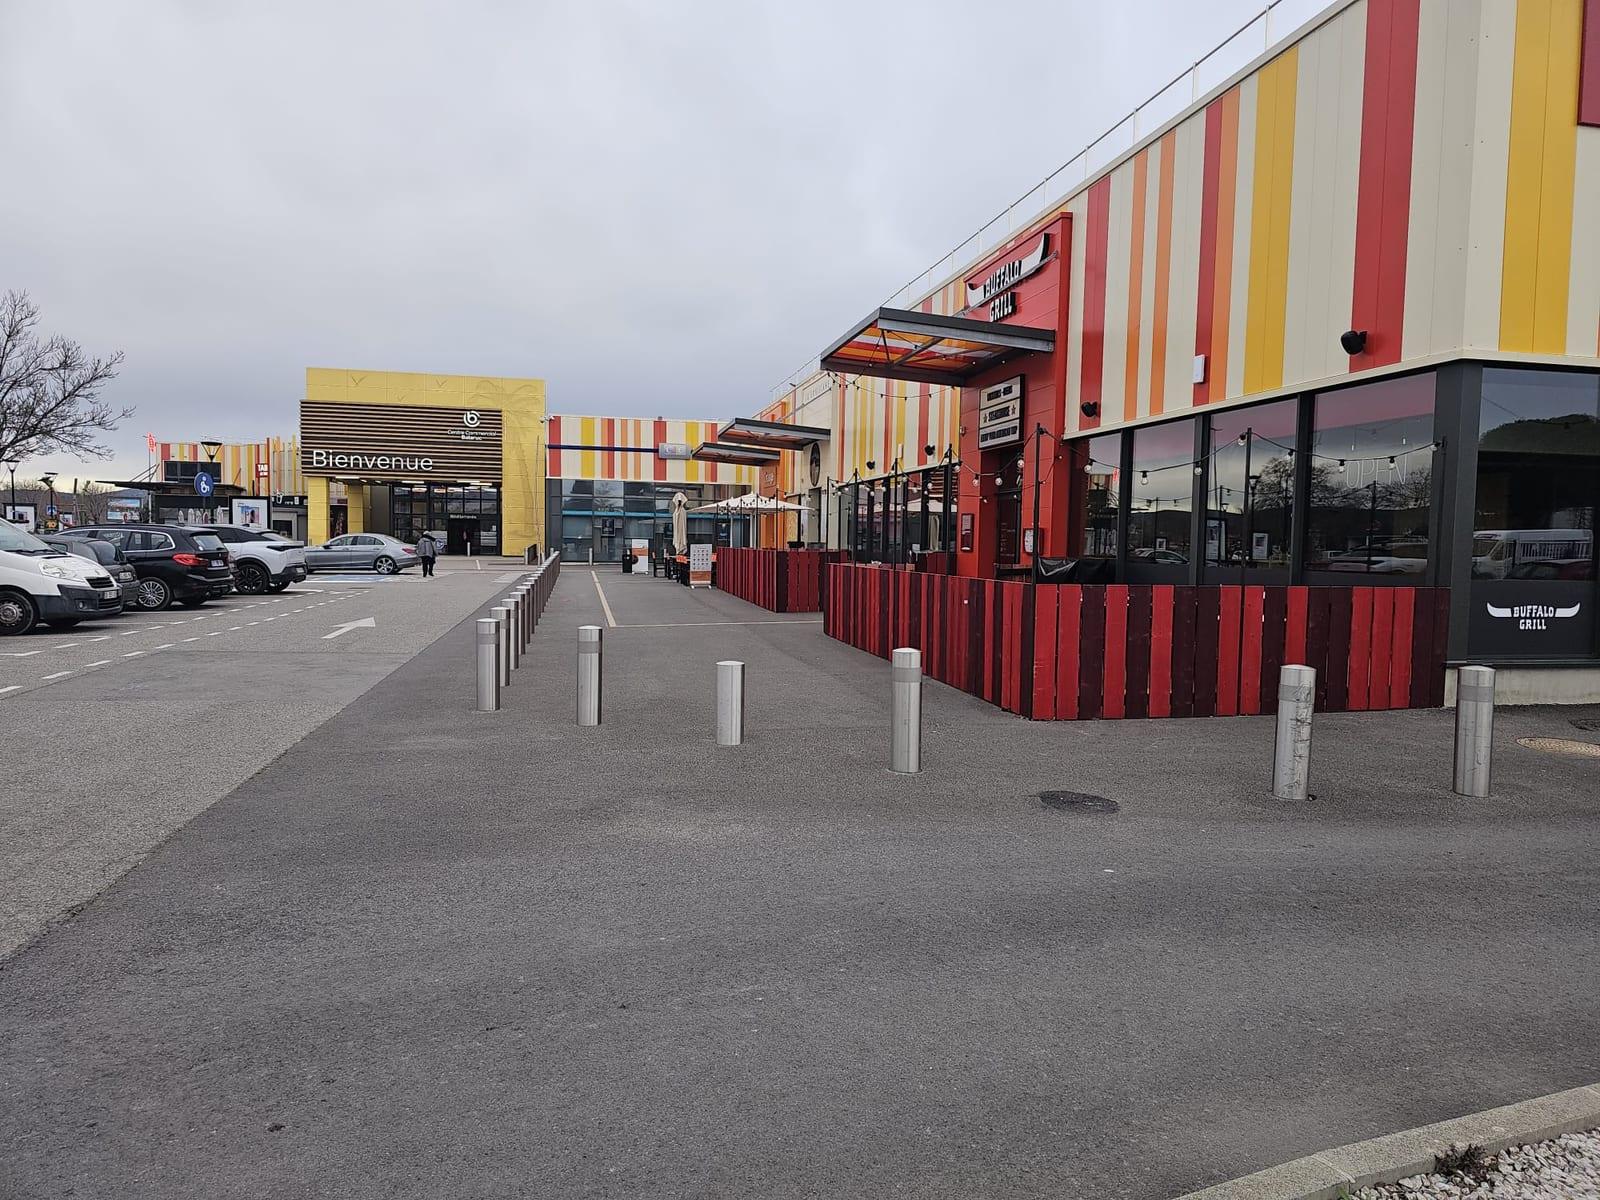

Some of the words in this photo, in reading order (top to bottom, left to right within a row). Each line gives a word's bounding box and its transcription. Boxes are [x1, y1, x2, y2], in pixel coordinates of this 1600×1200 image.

[984, 259, 1022, 298] BUFFALO
[989, 291, 1017, 322] GRILL
[312, 449, 433, 471] Bienvenue
[1346, 454, 1408, 489] OPEN
[1512, 604, 1555, 618] BUFFALO
[1519, 618, 1547, 630] GRILL
